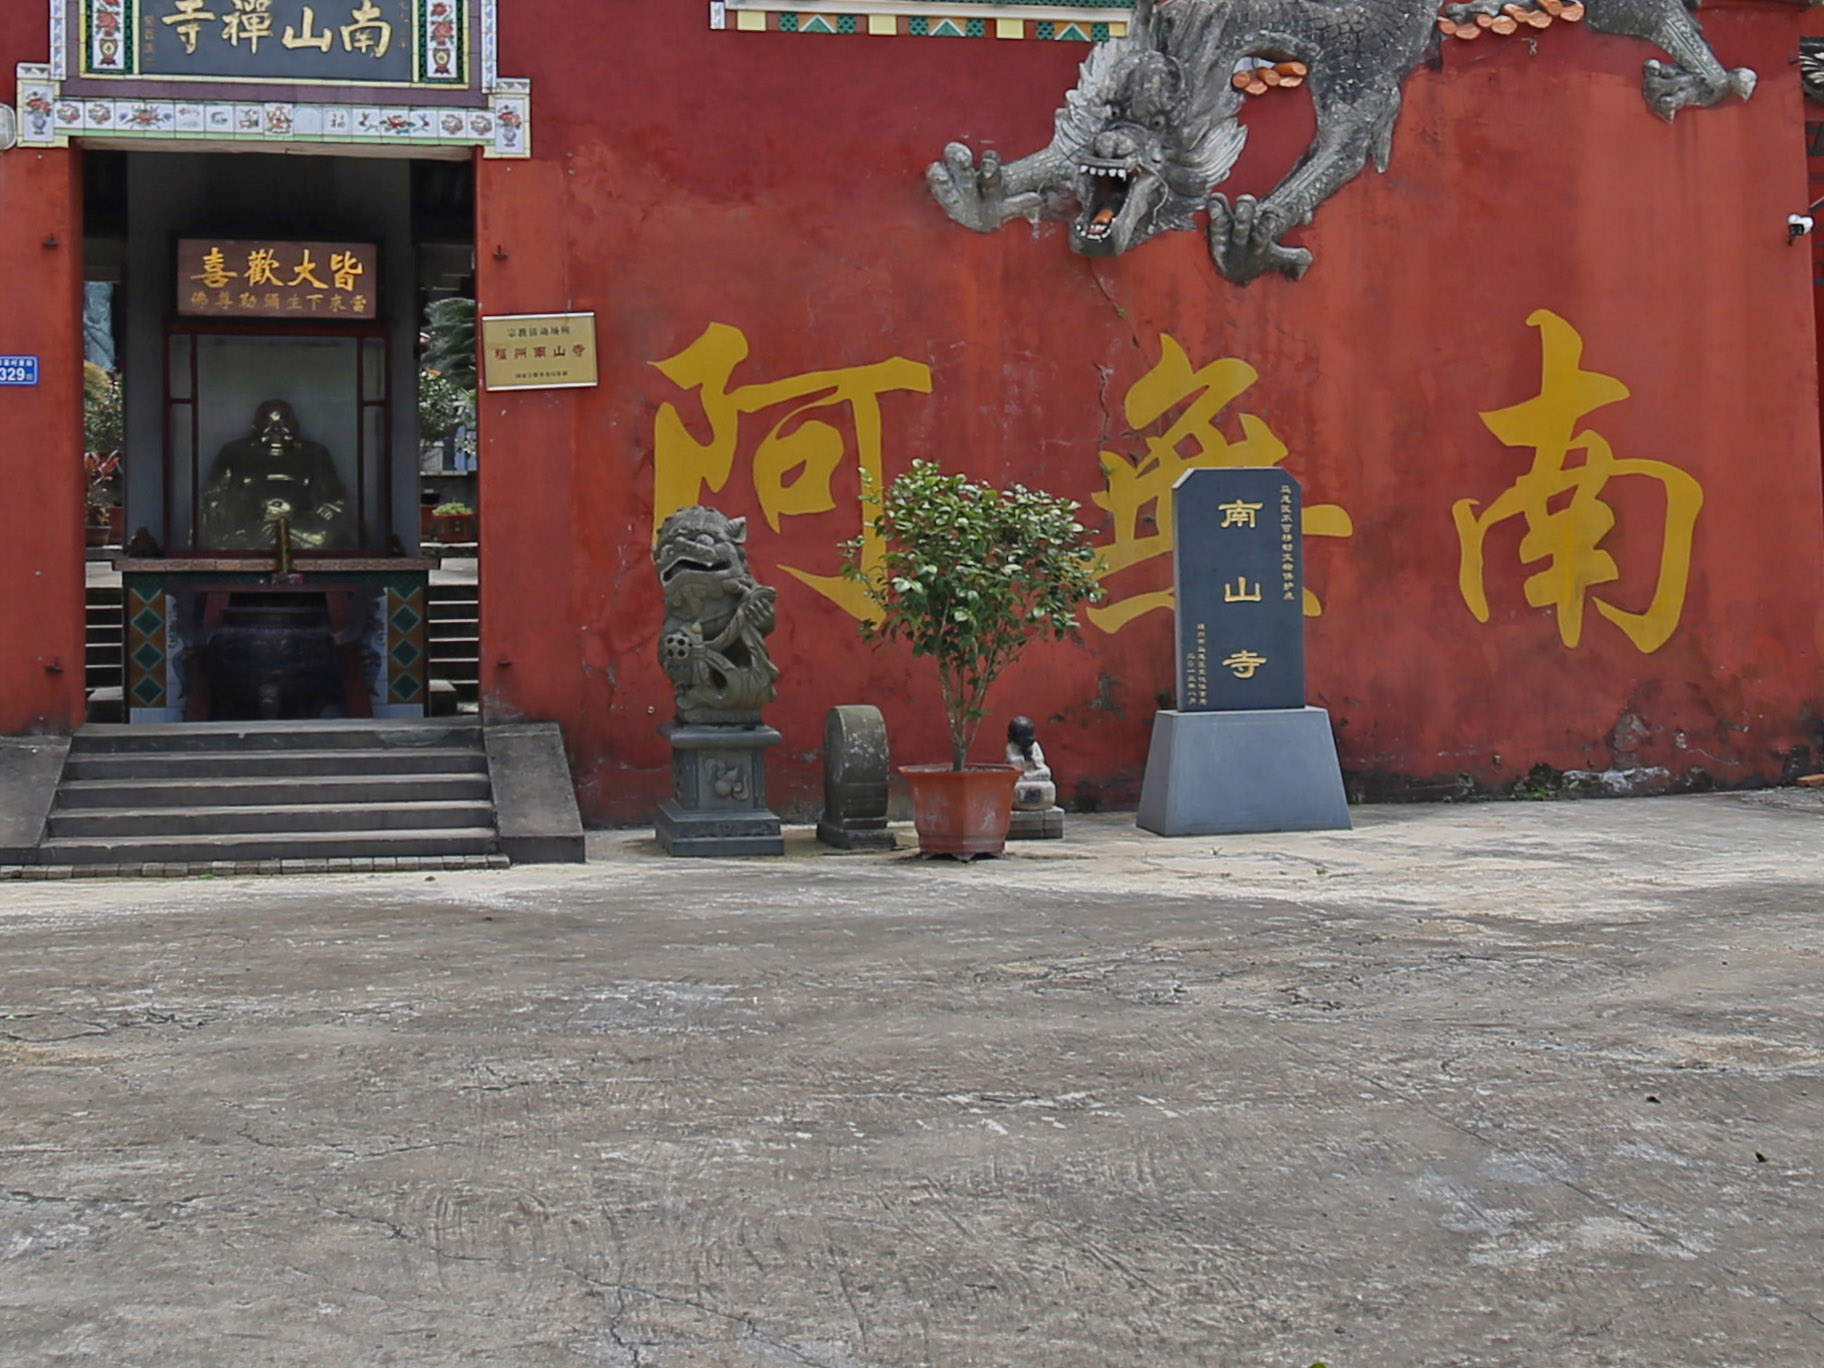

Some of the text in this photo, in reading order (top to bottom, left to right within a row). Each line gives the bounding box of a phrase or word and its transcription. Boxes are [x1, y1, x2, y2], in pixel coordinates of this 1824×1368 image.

[190, 247, 363, 292] 皆大歡喜
[1217, 498, 1268, 681] 南山寺
